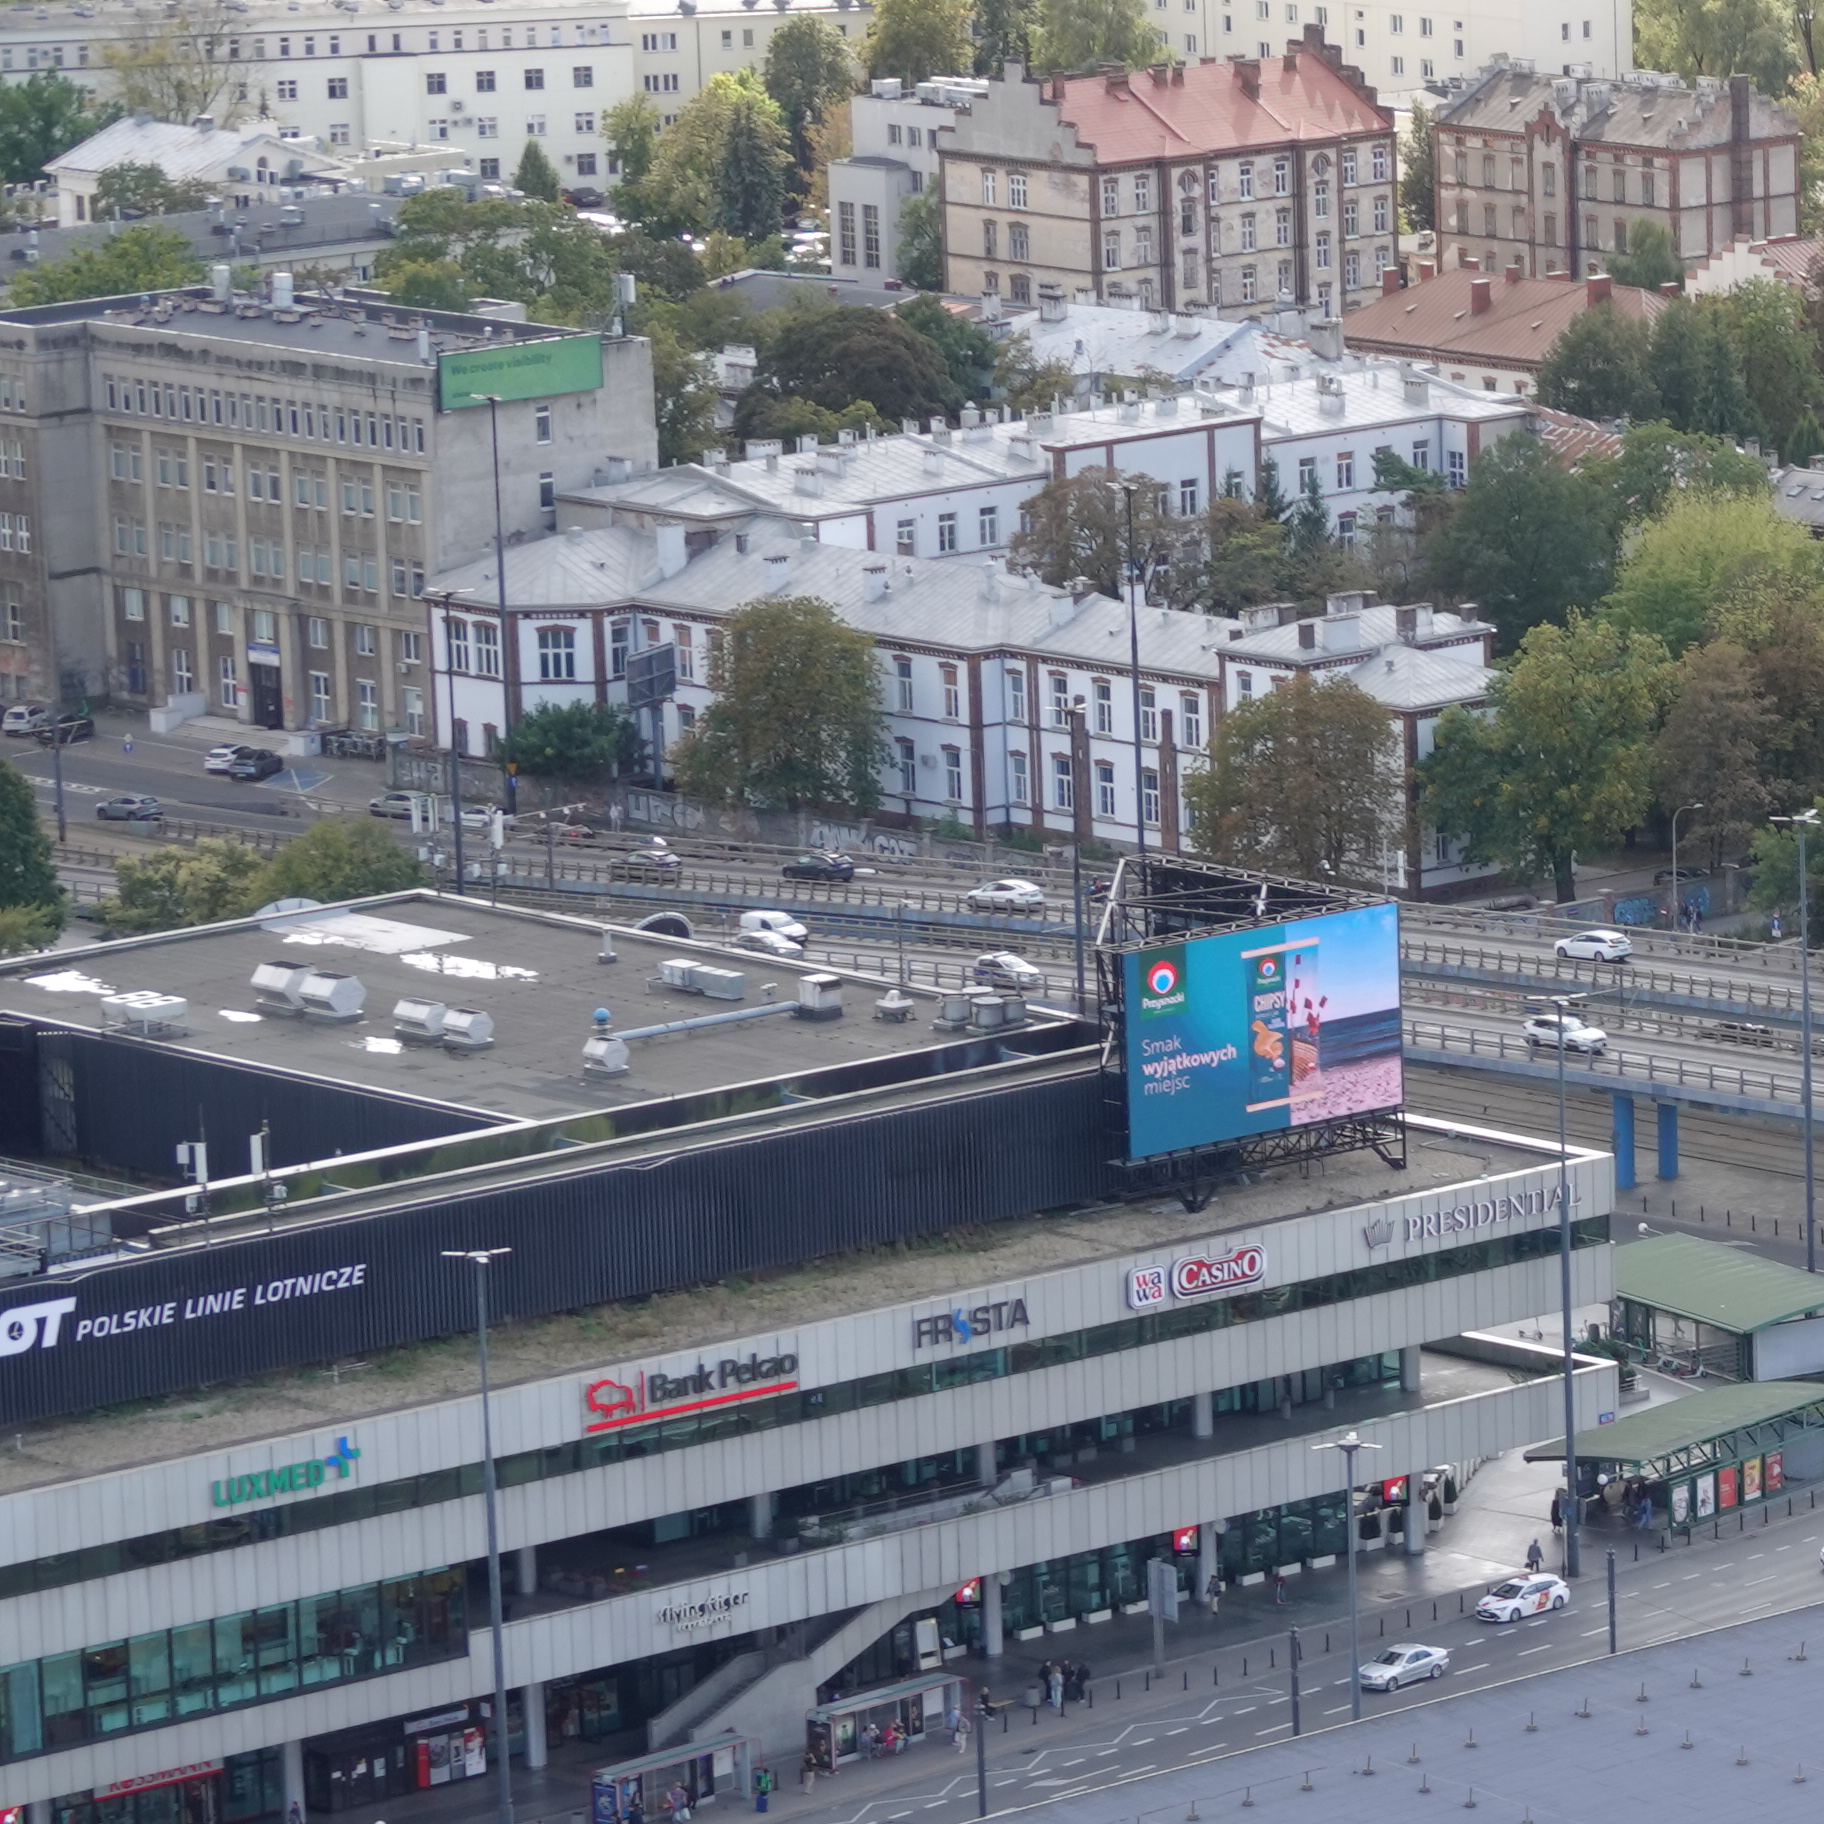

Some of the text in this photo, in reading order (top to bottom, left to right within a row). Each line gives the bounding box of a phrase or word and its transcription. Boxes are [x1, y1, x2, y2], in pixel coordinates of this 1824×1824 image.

[1253, 990, 1286, 1013] CHIPSY
[1141, 1035, 1182, 1056] Smak
[1142, 1044, 1237, 1079] wyjątkowych
[1144, 1073, 1191, 1096] miejsc
[1405, 1183, 1582, 1242] PRESIDENTIAL
[1178, 1252, 1262, 1290] CASINO
[0, 1264, 367, 1358] OT POLSKIE LINIE LOTNICZE
[649, 1353, 798, 1403] Bank Pekao
[213, 1459, 326, 1507] LUXMED
[660, 1592, 749, 1624] flying tiger
